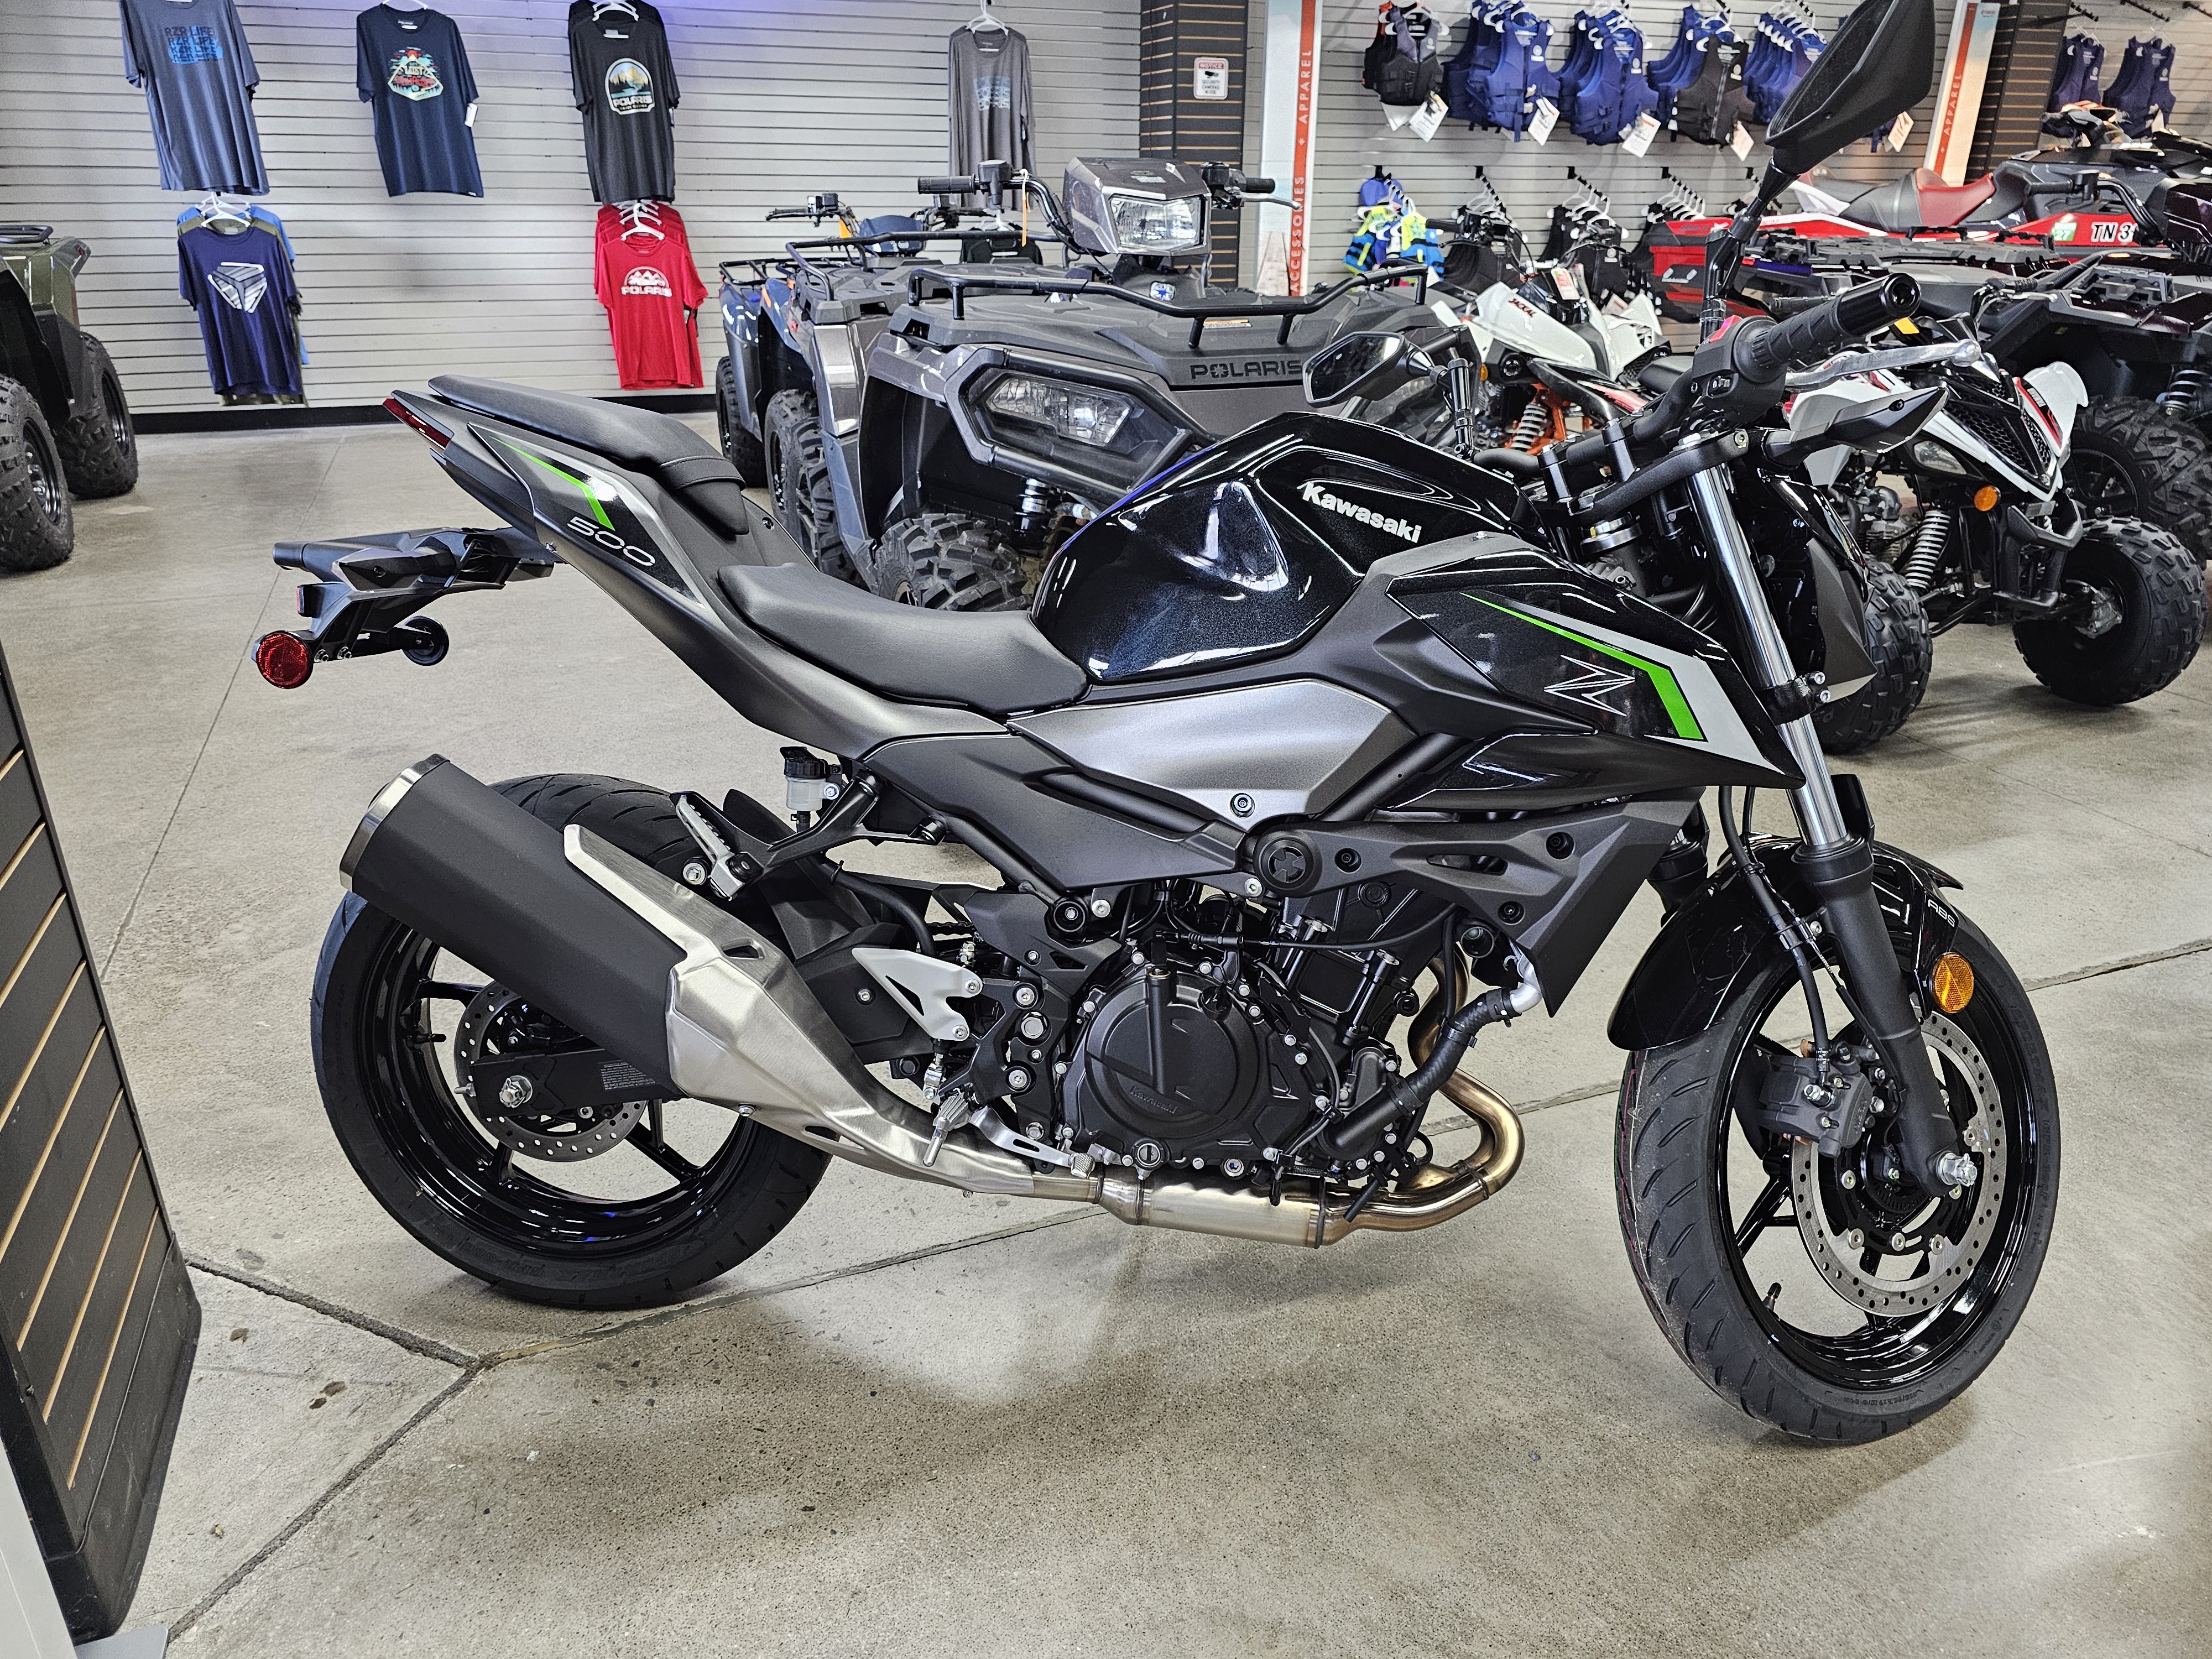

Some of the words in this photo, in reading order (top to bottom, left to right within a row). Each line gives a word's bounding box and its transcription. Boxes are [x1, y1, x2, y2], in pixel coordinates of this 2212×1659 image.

[612, 95, 653, 107] POLARIS
[1297, 50, 1312, 125] APPAREL
[1943, 74, 1962, 135] APPAREL
[2092, 223, 2117, 241] TN
[621, 286, 672, 298] POLARIS
[1509, 298, 1536, 317] JACKAL
[1190, 359, 1302, 380] POLARIS
[1302, 482, 1422, 544] Kawasaki
[567, 516, 656, 566] 500
[1927, 899, 1955, 927] ABS
[1130, 1086, 1178, 1114] Kawasaki
